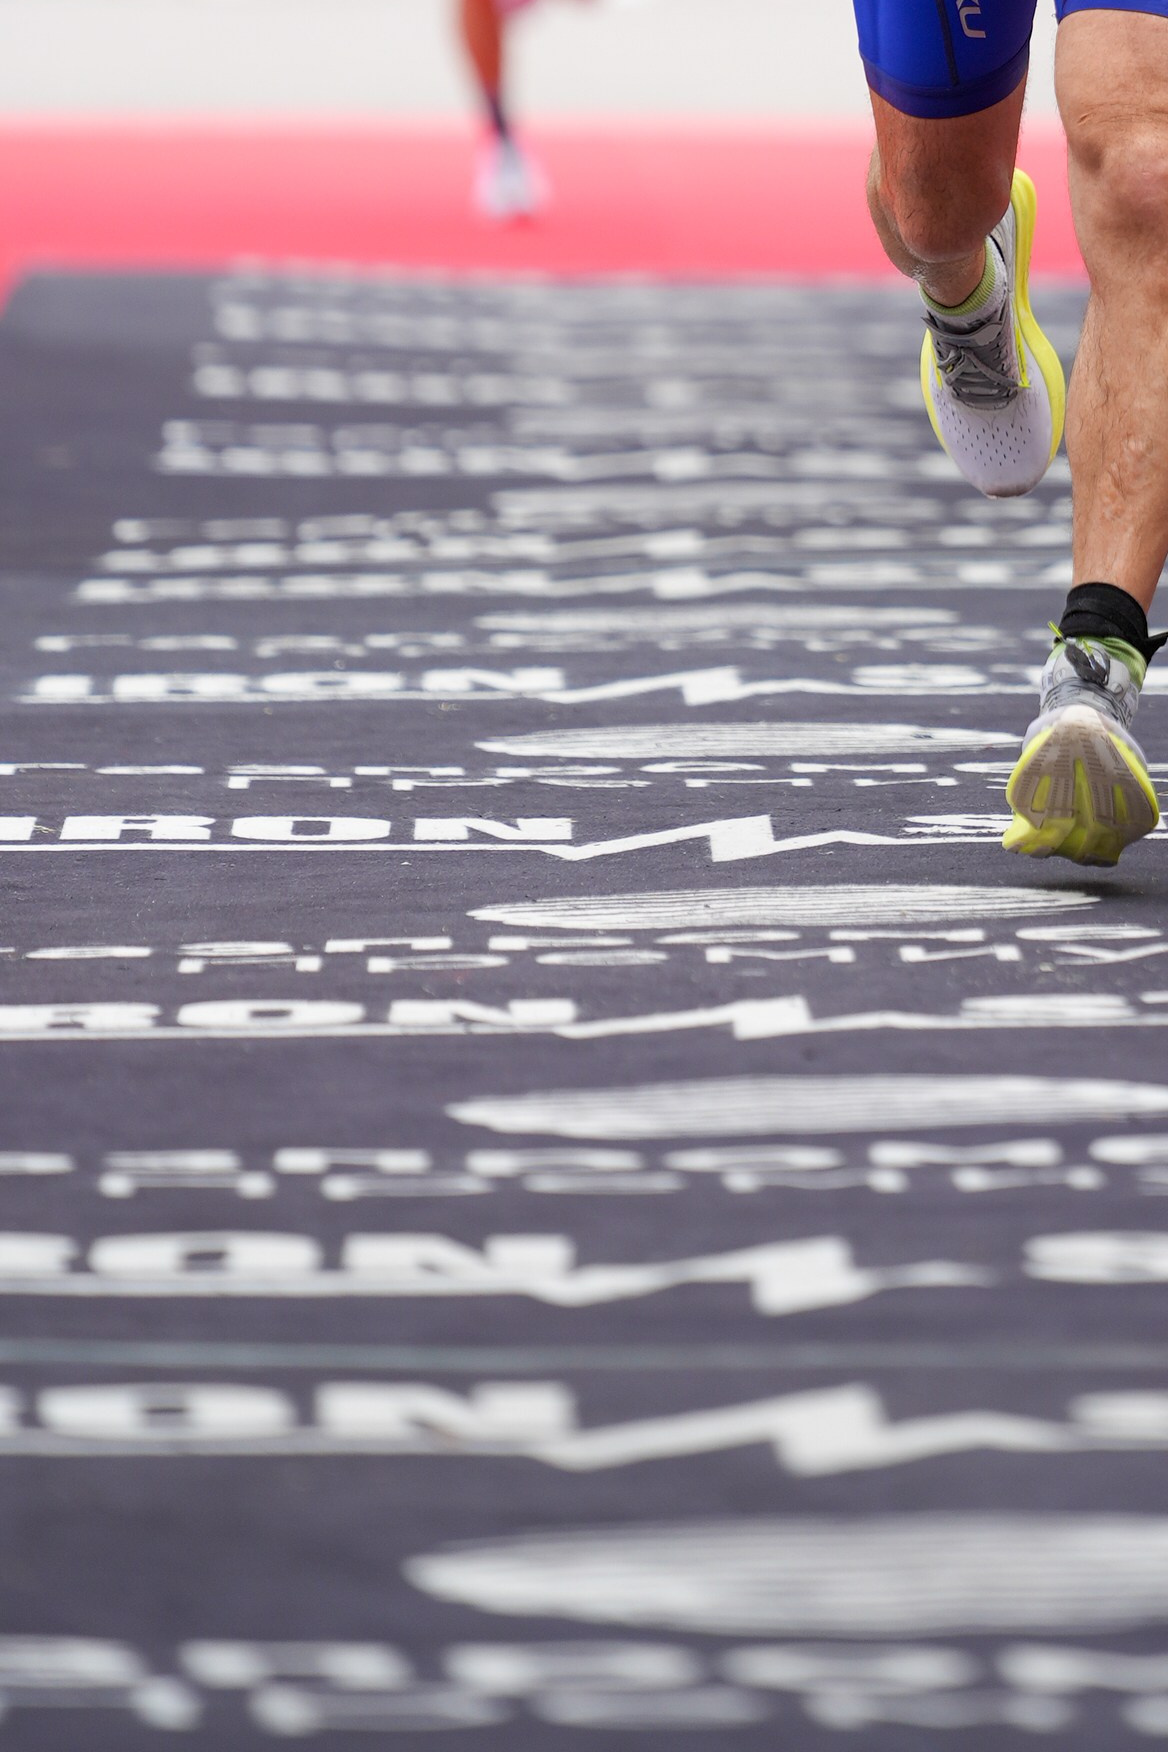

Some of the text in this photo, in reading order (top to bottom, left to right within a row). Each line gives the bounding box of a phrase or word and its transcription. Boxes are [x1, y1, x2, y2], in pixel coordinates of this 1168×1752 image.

[35, 668, 563, 699] IRON
[0, 815, 574, 841] IRON
[0, 1380, 578, 1442] ON
